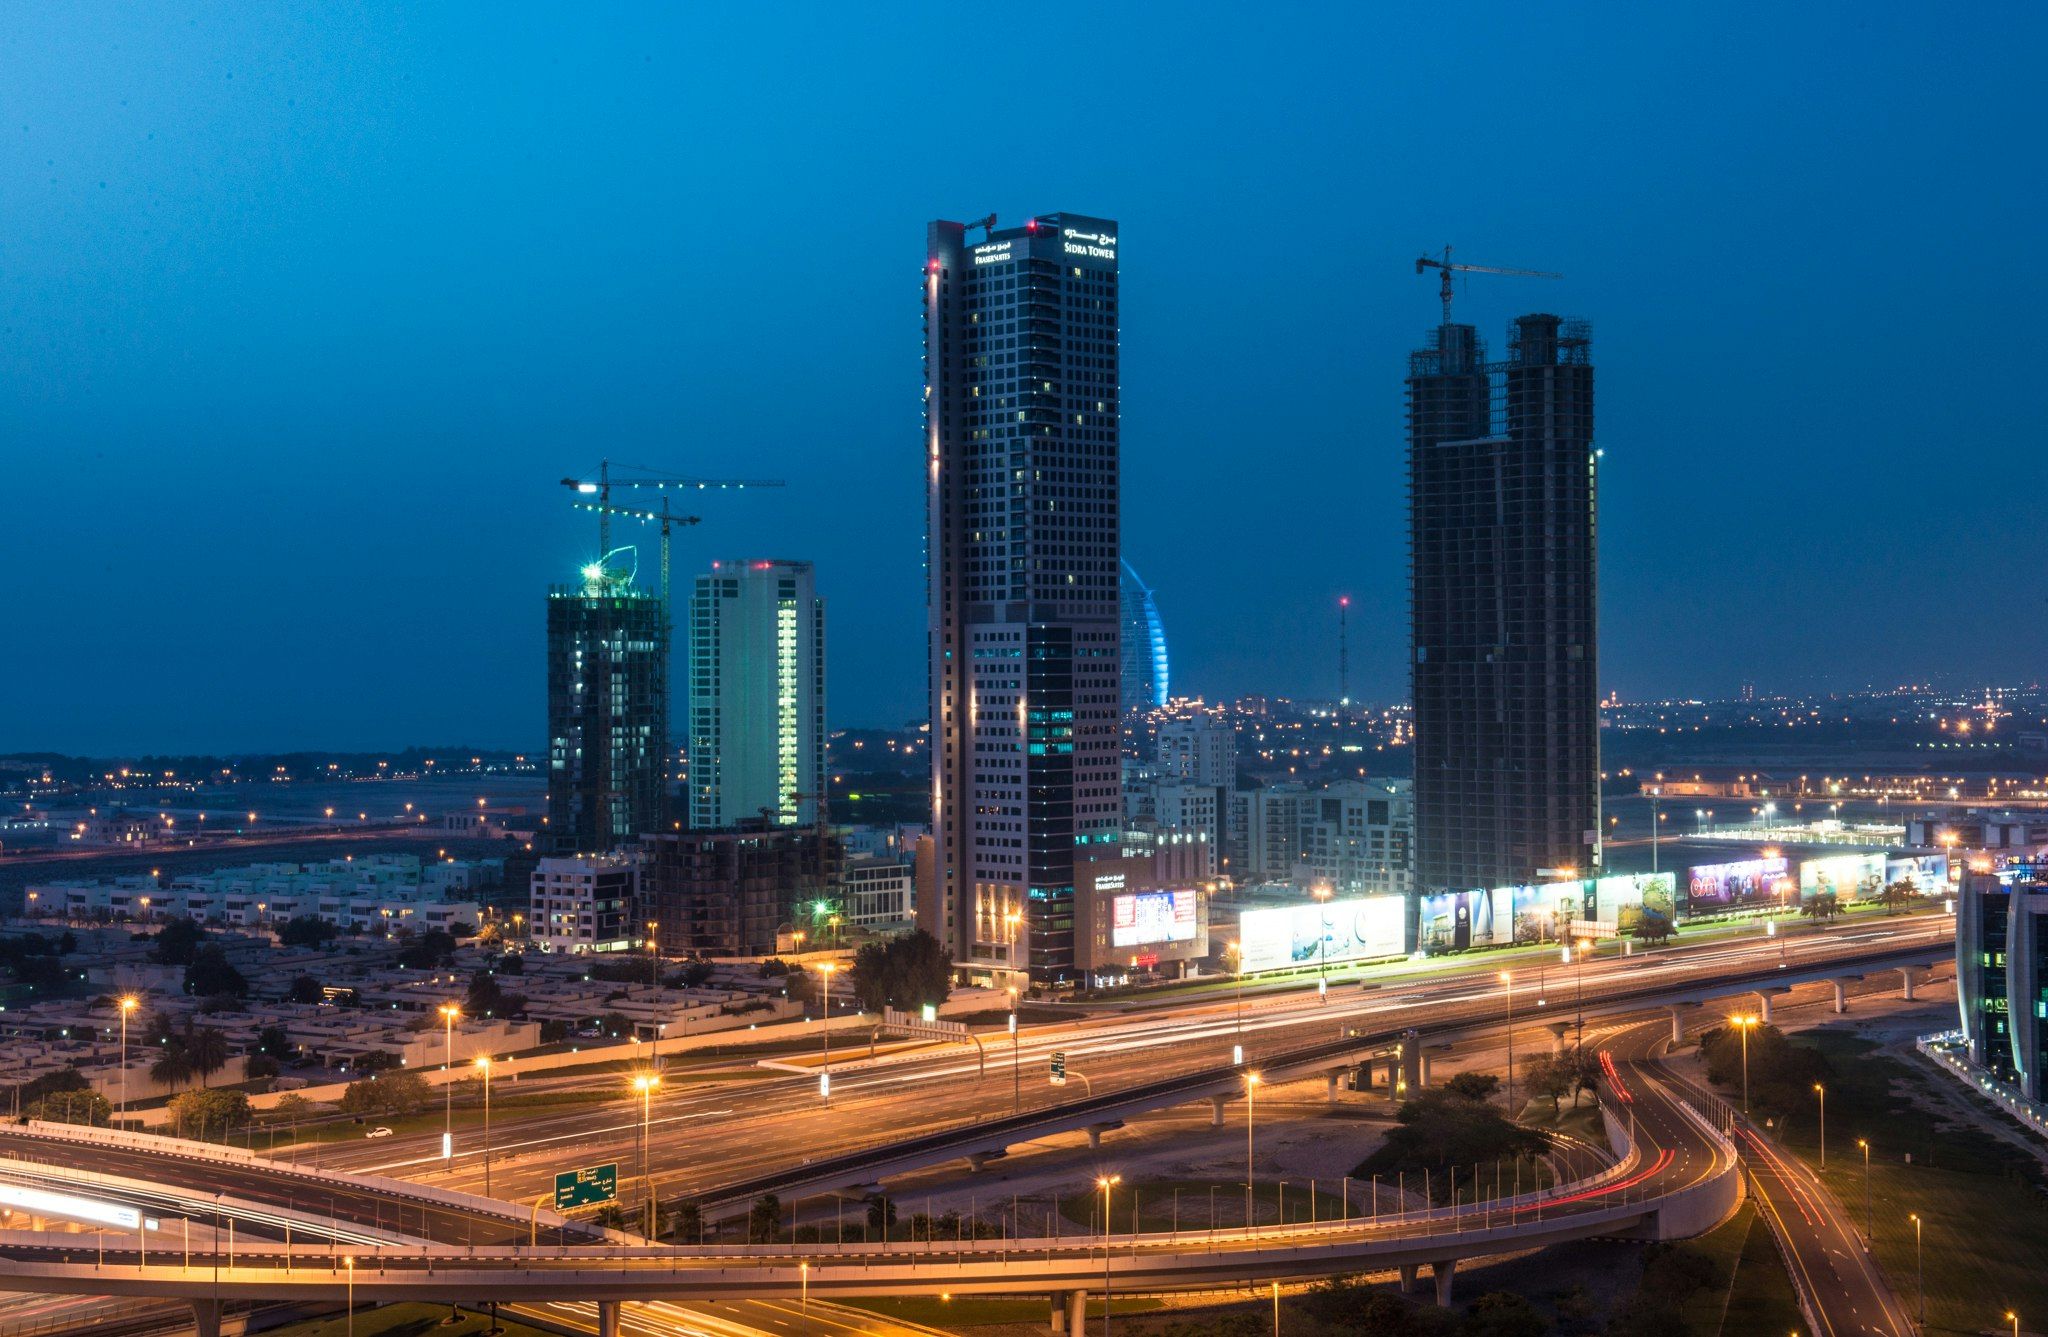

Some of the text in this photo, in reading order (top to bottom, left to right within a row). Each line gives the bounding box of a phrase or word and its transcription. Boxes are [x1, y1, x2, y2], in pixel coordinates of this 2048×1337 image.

[1099, 234, 1117, 246] برج
[1064, 242, 1115, 259] SIDRA TOWER
